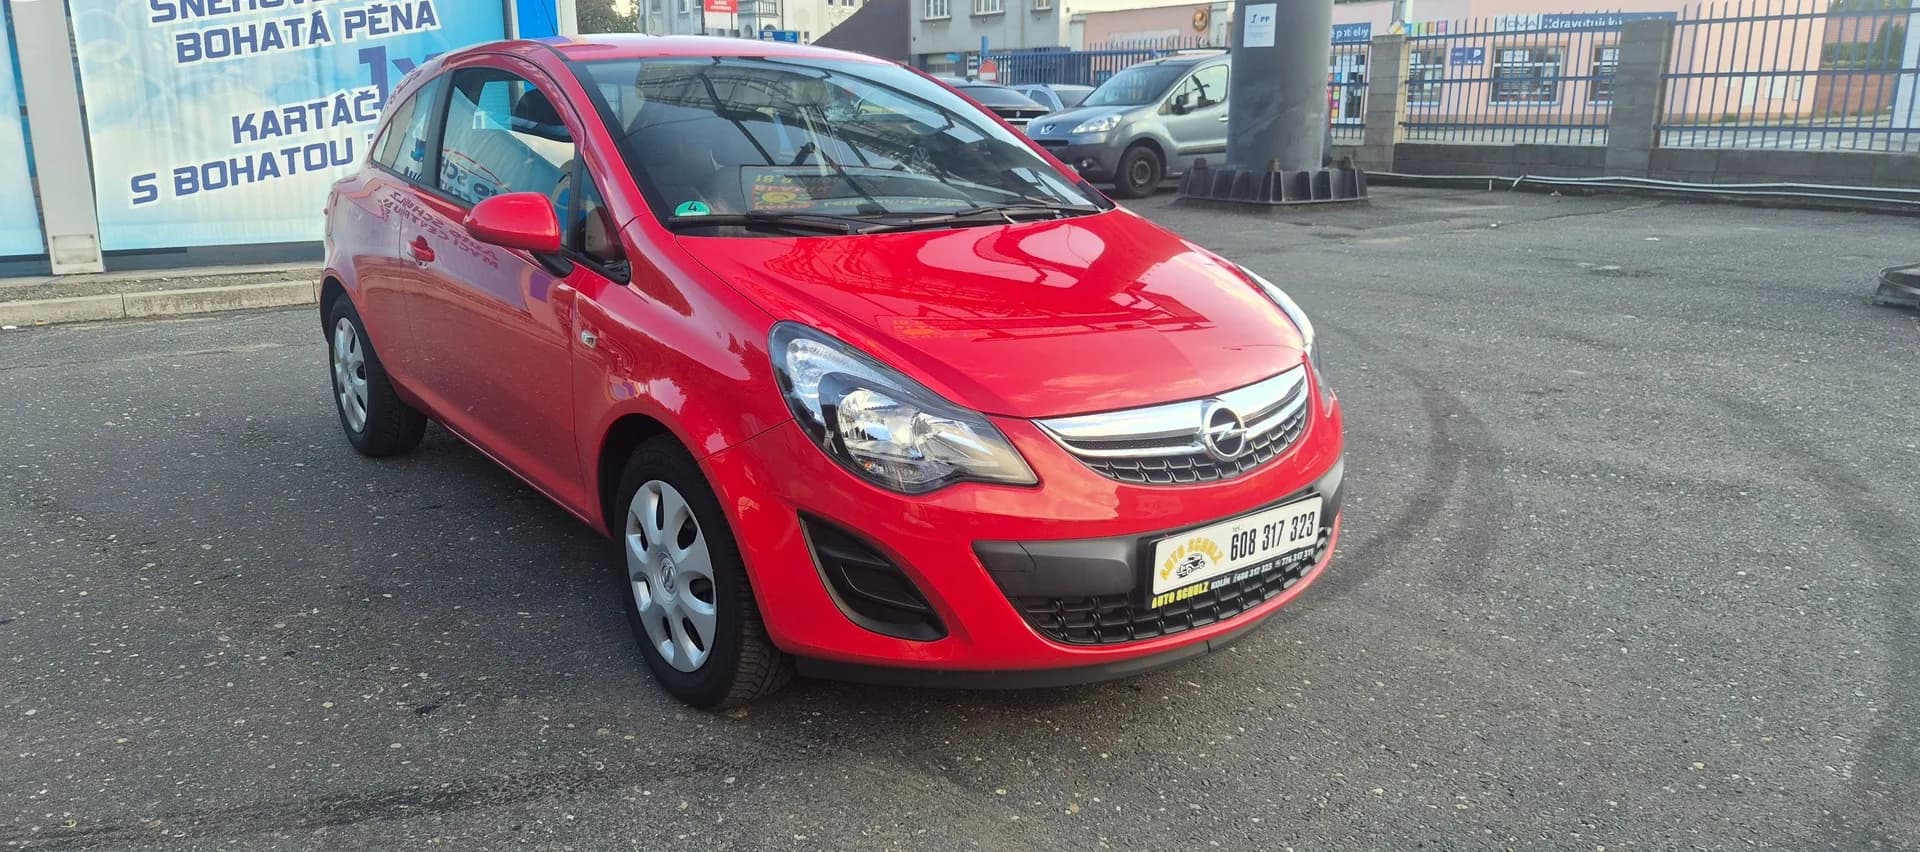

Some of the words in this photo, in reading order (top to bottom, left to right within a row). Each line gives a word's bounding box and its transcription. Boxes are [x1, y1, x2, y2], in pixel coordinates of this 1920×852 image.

[175, 9, 332, 64] BOHATÁ
[343, 0, 438, 40] PĚNA
[231, 90, 378, 145] KARTÁČ
[130, 172, 159, 205] S
[173, 137, 354, 197] BOHATOU
[686, 201, 697, 212] 4
[1231, 528, 1257, 561] 608
[1262, 519, 1285, 551] 317
[1290, 511, 1315, 542] 323
[1160, 544, 1185, 581] AUTO
[1151, 591, 1175, 609] AUTO
[1176, 581, 1210, 601] SCHULZ
